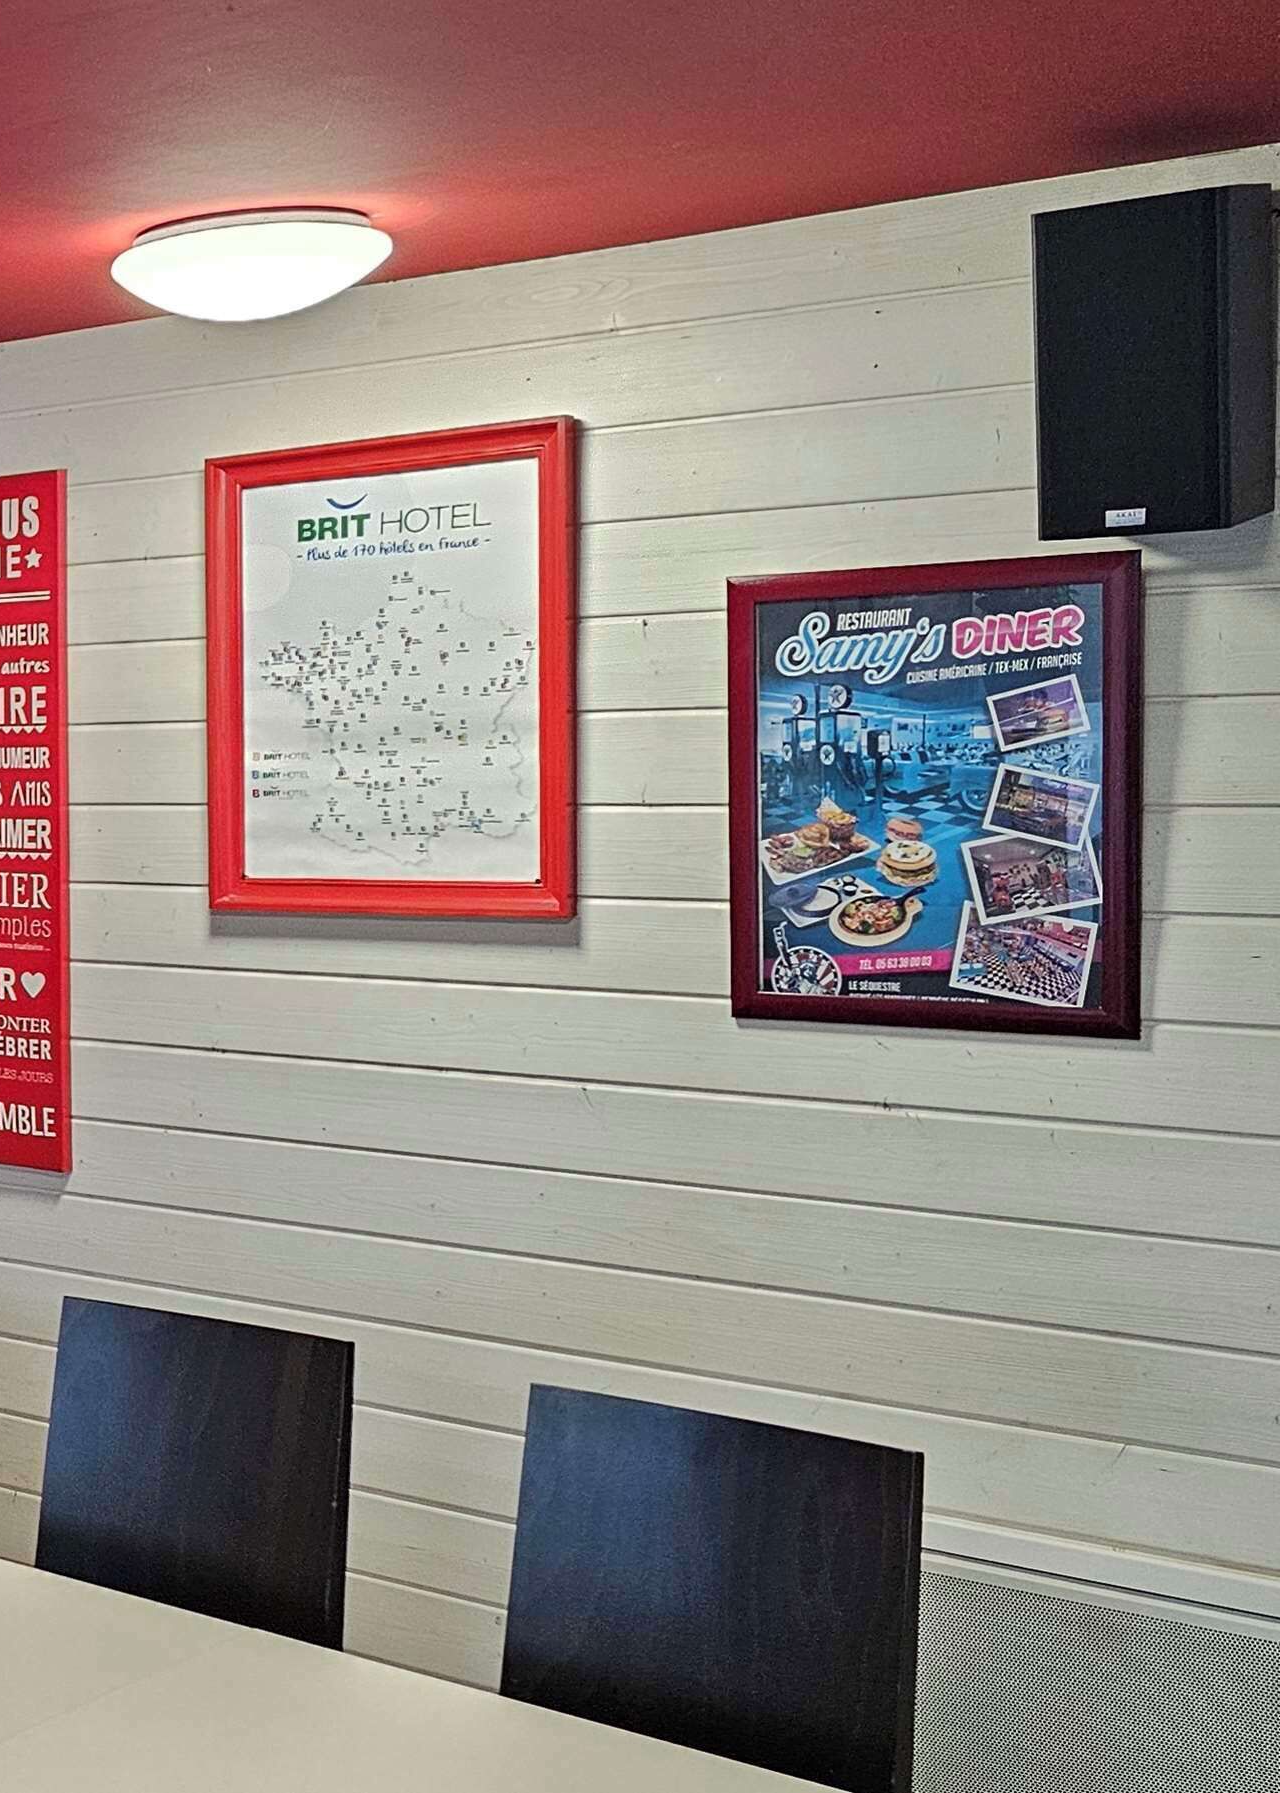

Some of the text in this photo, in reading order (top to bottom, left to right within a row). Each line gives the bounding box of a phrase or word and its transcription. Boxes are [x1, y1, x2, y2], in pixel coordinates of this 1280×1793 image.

[297, 502, 491, 543] BRIT HOTEL
[307, 546, 331, 561] Plus
[334, 546, 348, 559] de
[352, 543, 376, 556] 170
[418, 541, 434, 552] en
[439, 537, 479, 550] France
[836, 608, 912, 631] RESTAURANT
[775, 605, 1085, 684] Samy's DINER
[1, 657, 50, 675] autres
[906, 671, 938, 684] CUISINE
[938, 664, 987, 682] AMÉRICAINE
[994, 658, 1029, 675] TEX-MEX
[1036, 652, 1083, 670] FRANÇAISE
[10, 781, 52, 807] AMIS
[848, 981, 859, 991] LE
[18, 1070, 54, 1084] JOURS
